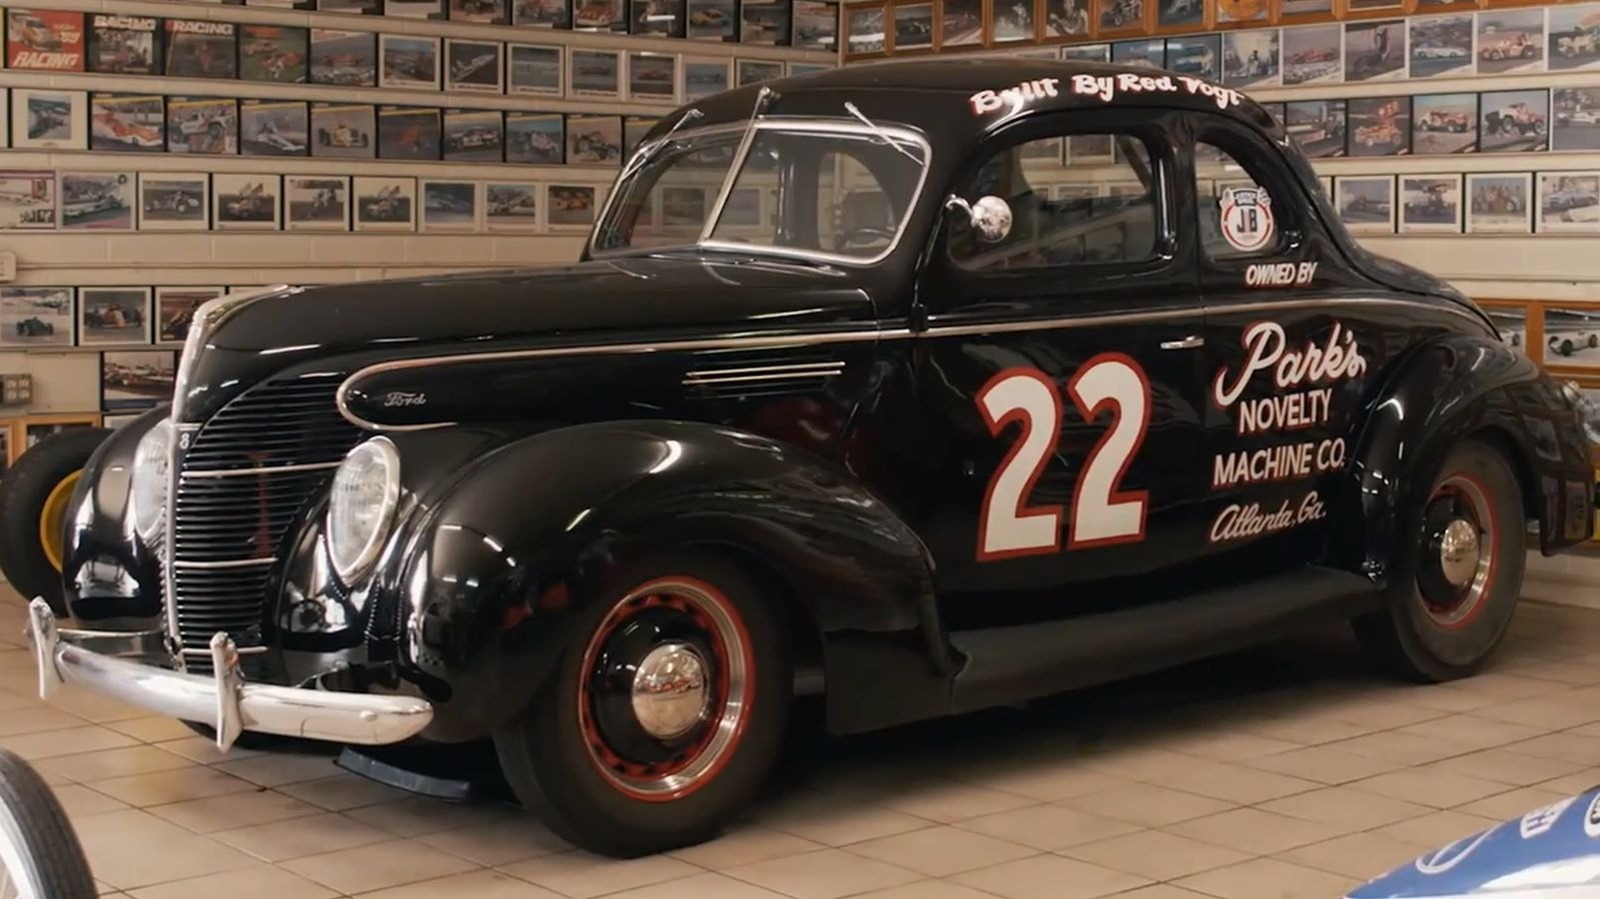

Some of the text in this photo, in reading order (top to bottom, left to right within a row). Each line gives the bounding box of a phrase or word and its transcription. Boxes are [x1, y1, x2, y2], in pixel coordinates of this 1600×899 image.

[93, 15, 157, 31] RACING
[173, 20, 233, 35] RACING
[12, 51, 79, 69] RACING
[969, 72, 1245, 115] Built By Red Vogt
[1245, 261, 1319, 286] OWNED BY
[1213, 320, 1368, 408] Park's
[383, 391, 427, 407] Ford
[1238, 388, 1333, 434] NOVELTY
[976, 354, 1150, 560] 22
[1212, 437, 1346, 487] MACHINE CO.
[1210, 490, 1327, 542] Atlanta, Ga.
